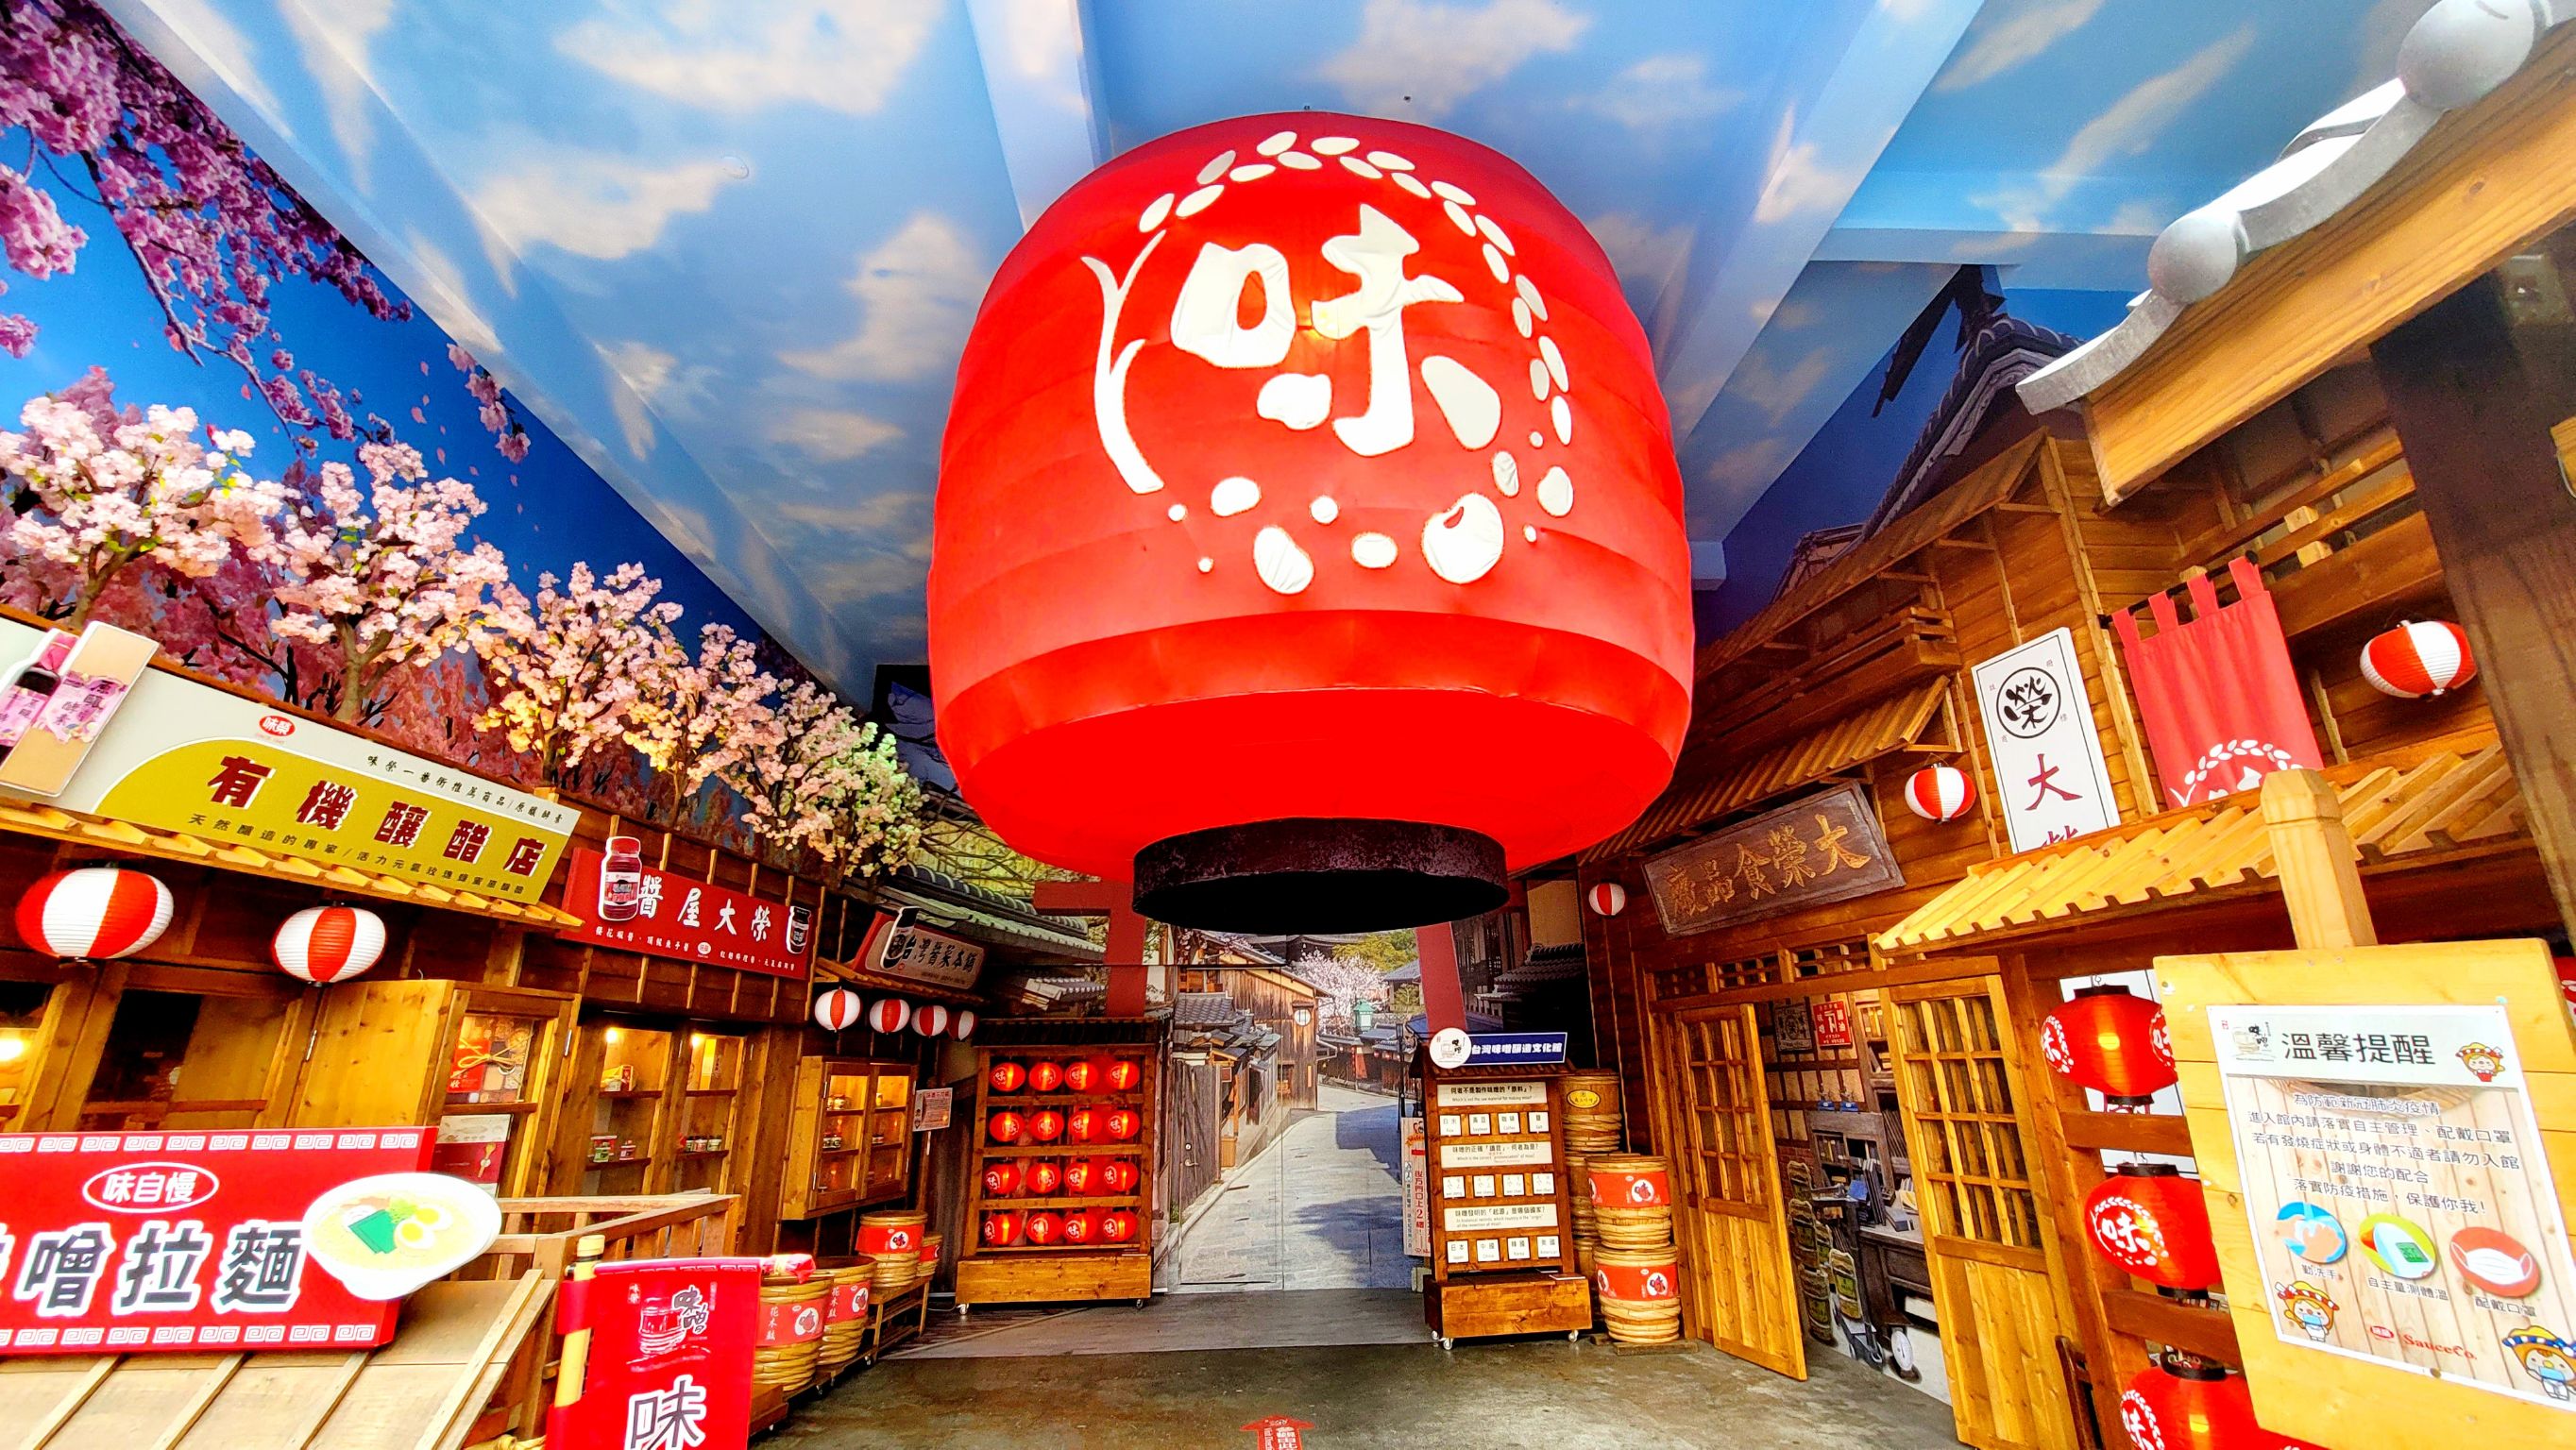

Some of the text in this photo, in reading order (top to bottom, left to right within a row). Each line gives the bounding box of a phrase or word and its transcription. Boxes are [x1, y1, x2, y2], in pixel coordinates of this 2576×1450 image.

[1170, 203, 1502, 457] 味
[207, 755, 548, 877] 有機釀醋店
[2281, 1033, 2437, 1068] 溫馨提醒
[2294, 1094, 2440, 1116] 為防範新冠肺炎疫情
[2252, 1132, 2520, 1170] 若有發燒症狀或身體不適者請勿入館
[102, 1172, 197, 1205] 味自慢
[2330, 1160, 2430, 1184] 謝謝您的配合
[0, 1224, 302, 1310] 噌拉麵
[2301, 1263, 2338, 1281] 勤洗手
[2367, 1276, 2449, 1302] 自主量測體溫
[629, 1378, 703, 1450] 味
